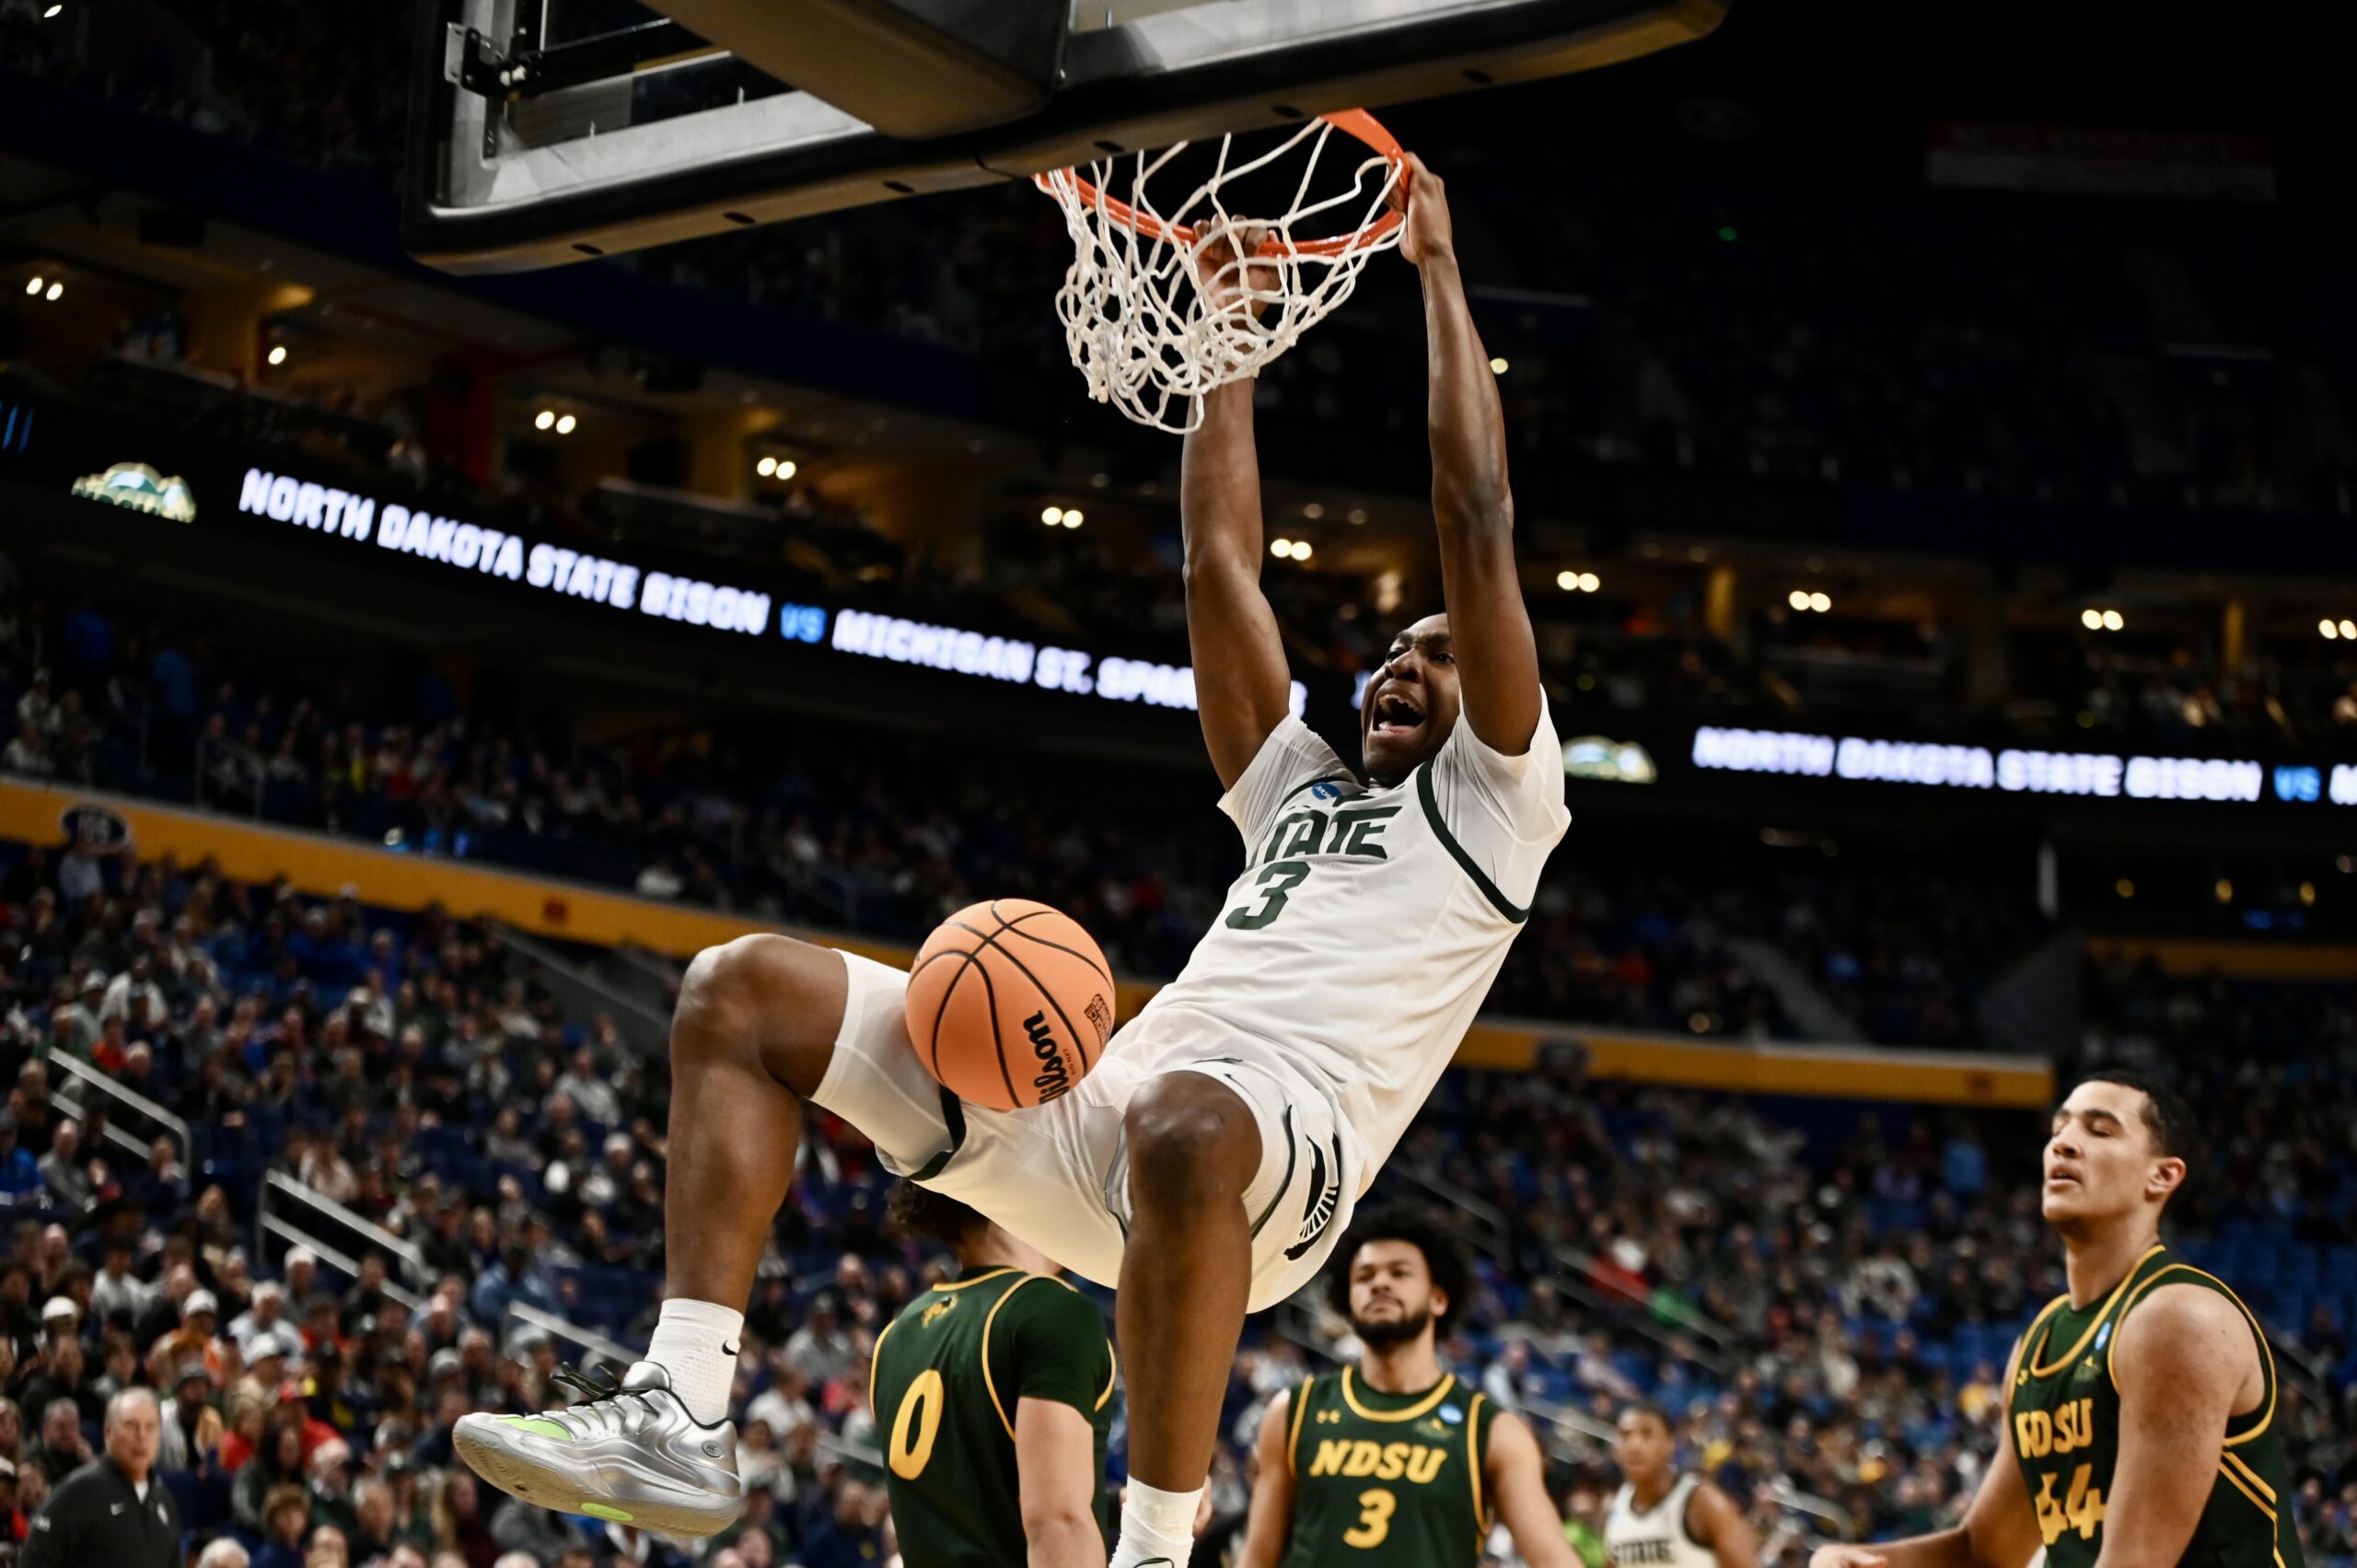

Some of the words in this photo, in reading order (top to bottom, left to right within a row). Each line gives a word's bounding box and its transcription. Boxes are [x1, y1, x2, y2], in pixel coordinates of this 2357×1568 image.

[238, 468, 376, 541] NORTH
[377, 504, 524, 581] DAKOTA
[526, 543, 640, 610] STATE
[640, 571, 772, 636] BISON
[780, 603, 827, 644] VS
[831, 608, 1036, 683] MICHIGAN
[1037, 646, 1094, 694] ST.
[1996, 749, 2122, 796] STATE
[2124, 756, 2263, 802] BISON
[2273, 766, 2322, 802] VS
[1263, 806, 1402, 864] TATE
[1225, 861, 1311, 930] 3
[889, 1368, 944, 1481] 0
[1309, 1438, 1448, 1484] NDSU
[1342, 1488, 1397, 1550] 3
[2035, 1463, 2107, 1546] 44
